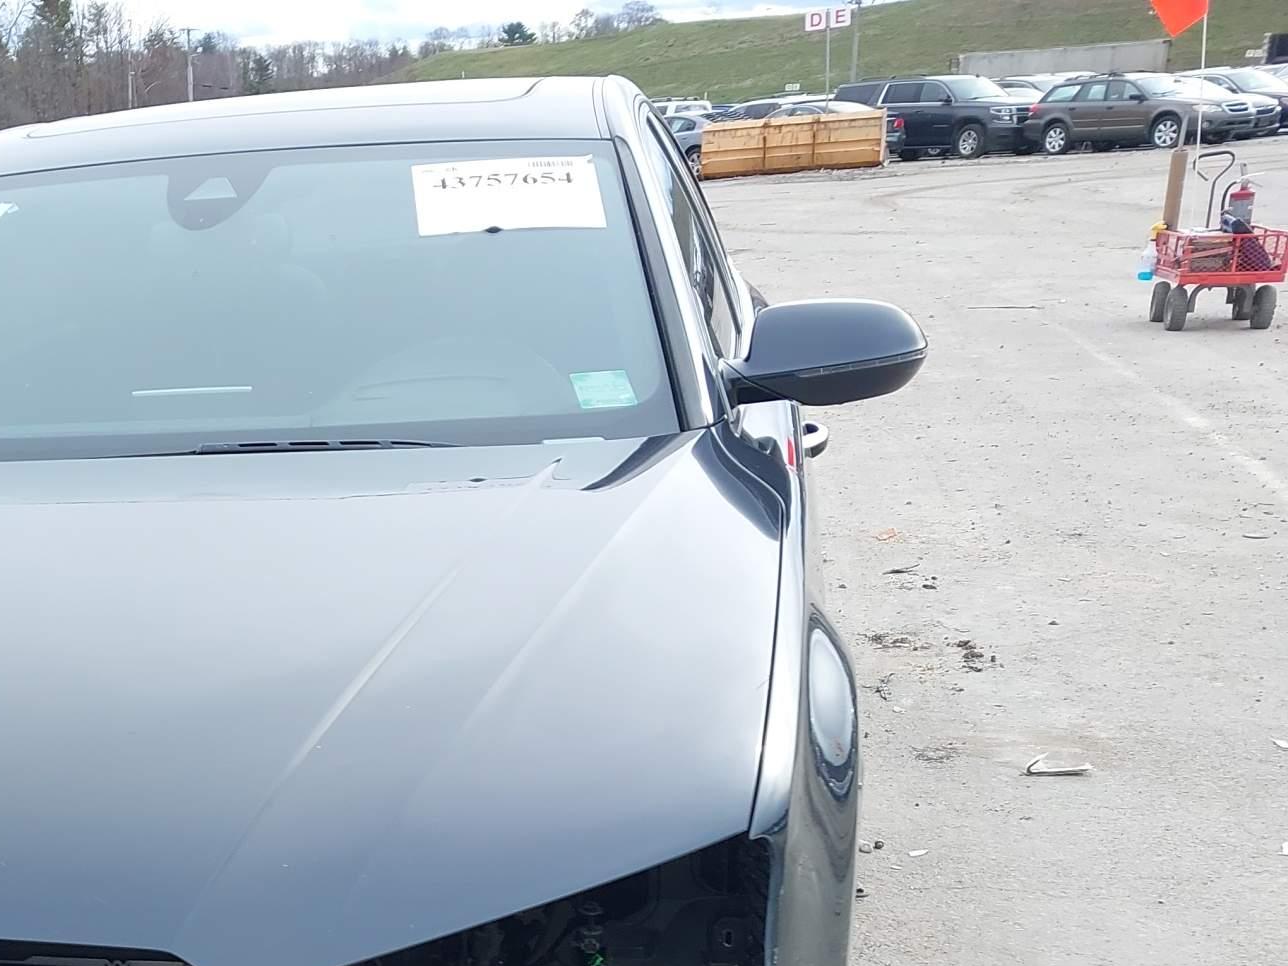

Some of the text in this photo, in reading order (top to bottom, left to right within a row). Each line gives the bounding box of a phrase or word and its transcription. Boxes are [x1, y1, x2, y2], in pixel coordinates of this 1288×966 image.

[810, 9, 846, 27] D E
[432, 171, 574, 190] 43757654
